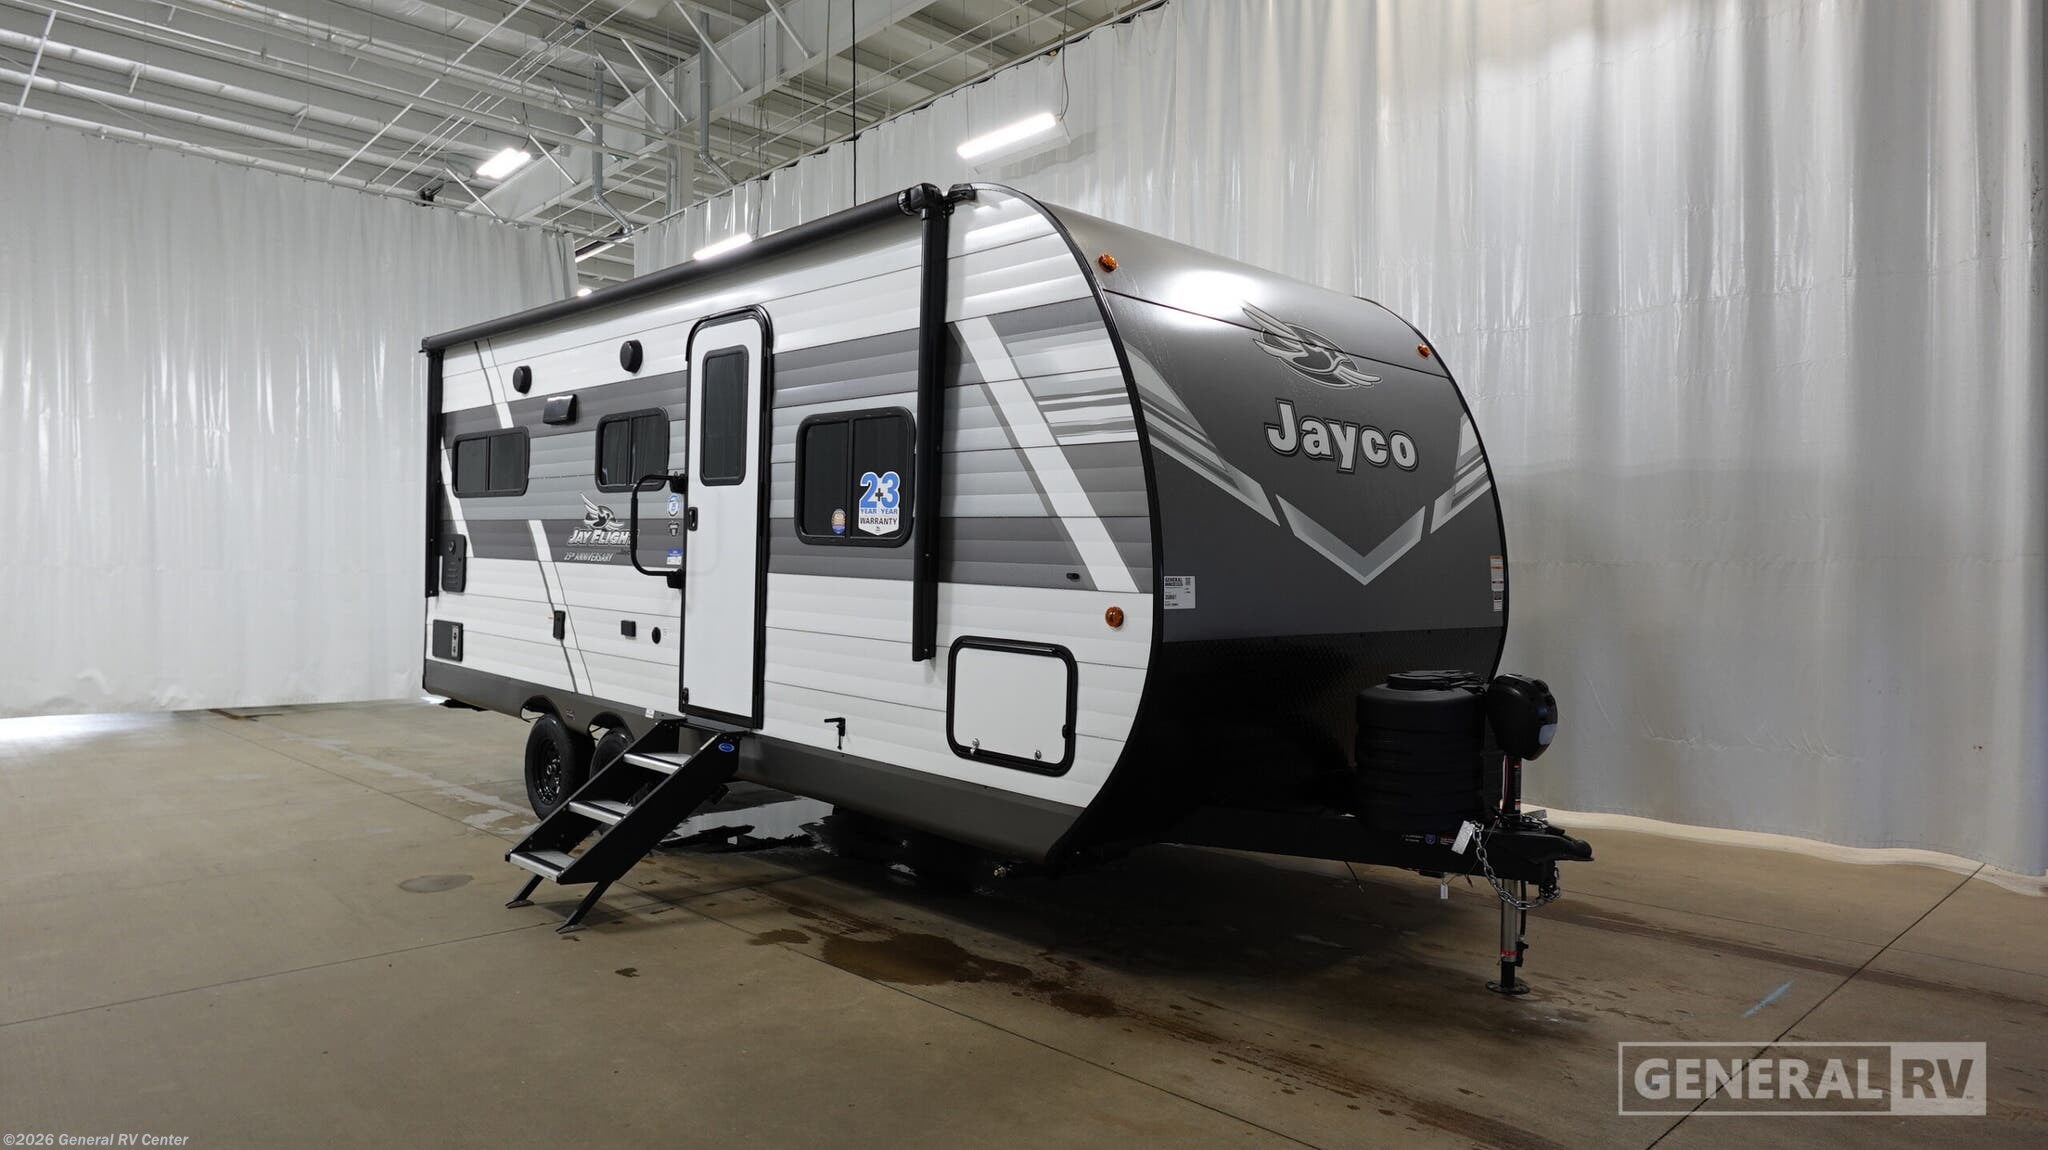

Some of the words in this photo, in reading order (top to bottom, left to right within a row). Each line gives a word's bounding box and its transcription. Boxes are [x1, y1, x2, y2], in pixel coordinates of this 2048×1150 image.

[1265, 399, 1418, 473] Jayco
[860, 517, 898, 525] WARRANTY
[568, 529, 593, 545] JAY
[590, 529, 639, 546] FLIGH
